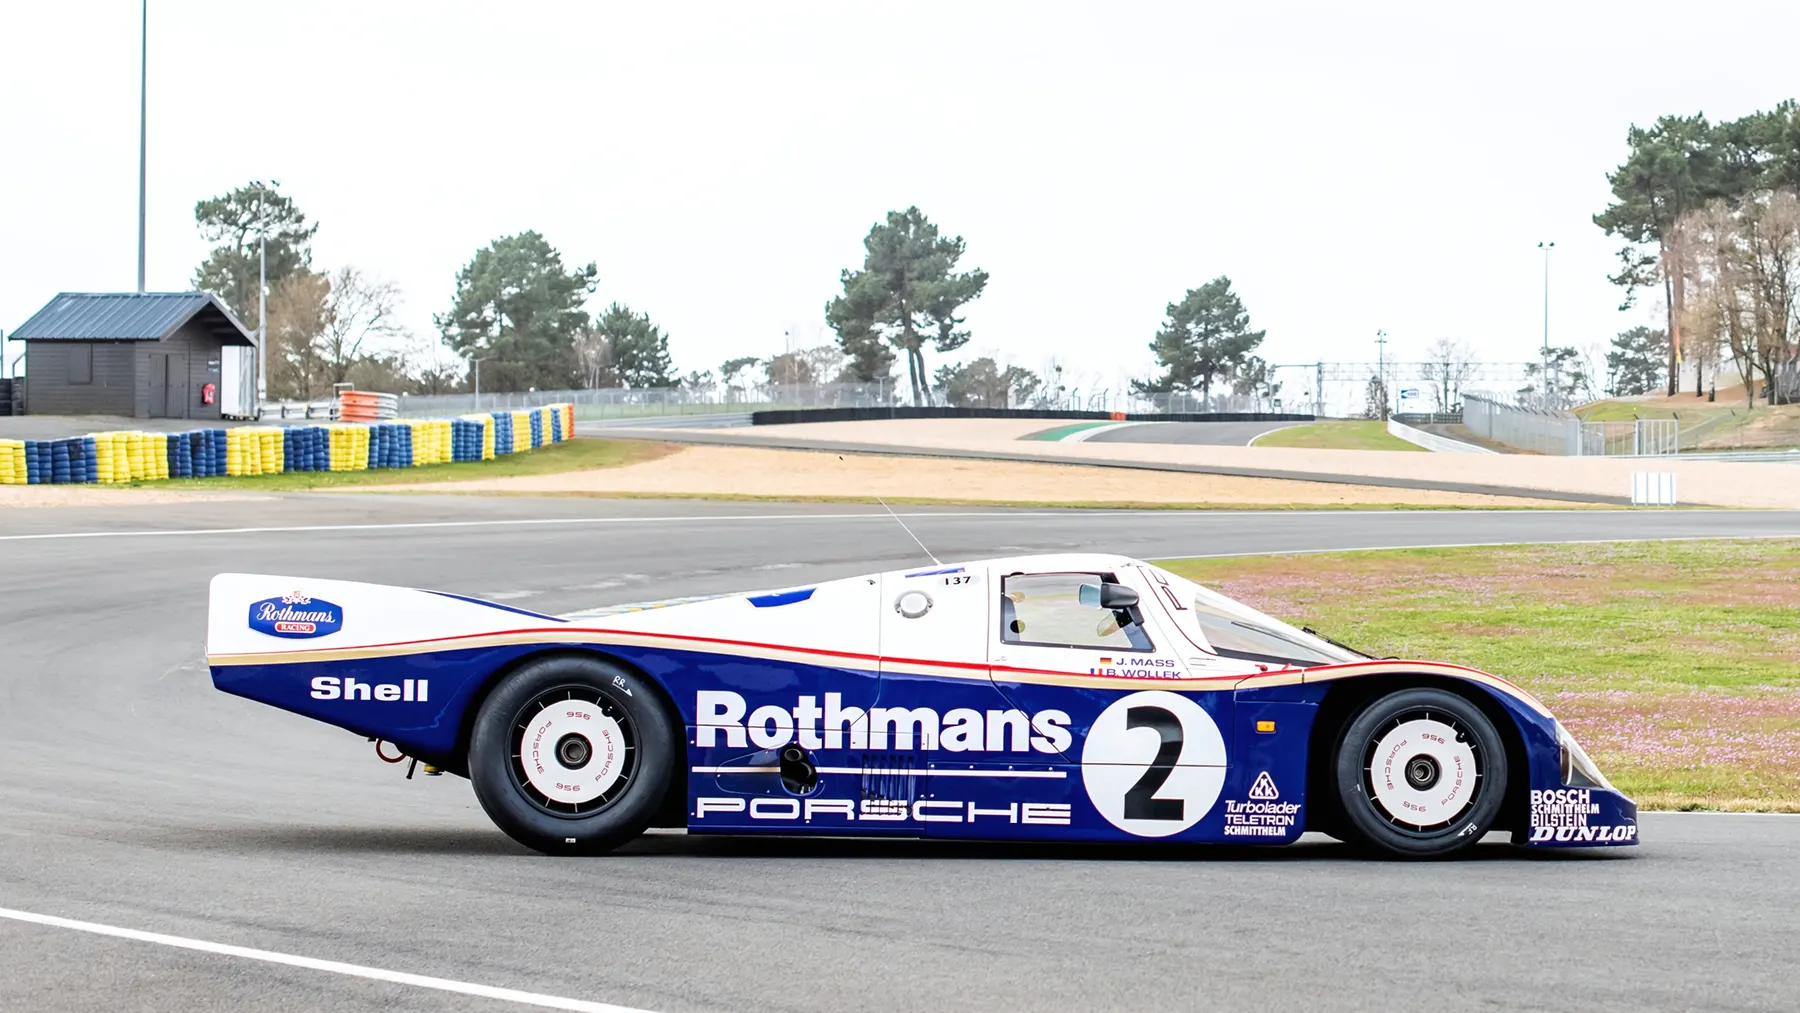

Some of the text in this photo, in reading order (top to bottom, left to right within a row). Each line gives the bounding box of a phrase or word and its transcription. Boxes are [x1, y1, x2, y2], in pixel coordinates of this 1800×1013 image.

[944, 575, 972, 586] 137
[256, 602, 336, 623] Rothmans
[280, 623, 310, 632] RACING
[1116, 657, 1175, 668] J. MASS
[612, 675, 626, 687] RR
[1121, 669, 1181, 680] WOLLEK
[310, 676, 429, 702] Shell
[566, 711, 592, 721] 956
[695, 690, 1073, 754] Rothmans
[1421, 733, 1446, 745] 956
[532, 720, 553, 775] PORSCHE
[594, 729, 614, 782] PORSCHE
[1123, 705, 1185, 821] 2
[1384, 739, 1408, 791] PORSCHE
[555, 782, 581, 792] 956
[1440, 755, 1463, 806] PORSCHE
[1530, 789, 1590, 804] BOSCH
[696, 797, 1072, 825] PORSCHE
[1225, 800, 1302, 814] Turbolader
[1401, 800, 1427, 812] 956
[1530, 803, 1600, 814] SCHMITTHELM
[1224, 814, 1294, 826] TELETRON
[1531, 814, 1587, 827] BILSTEIN
[1224, 825, 1286, 836] SCHMITTHELM
[1529, 825, 1636, 841] DUNLOP
